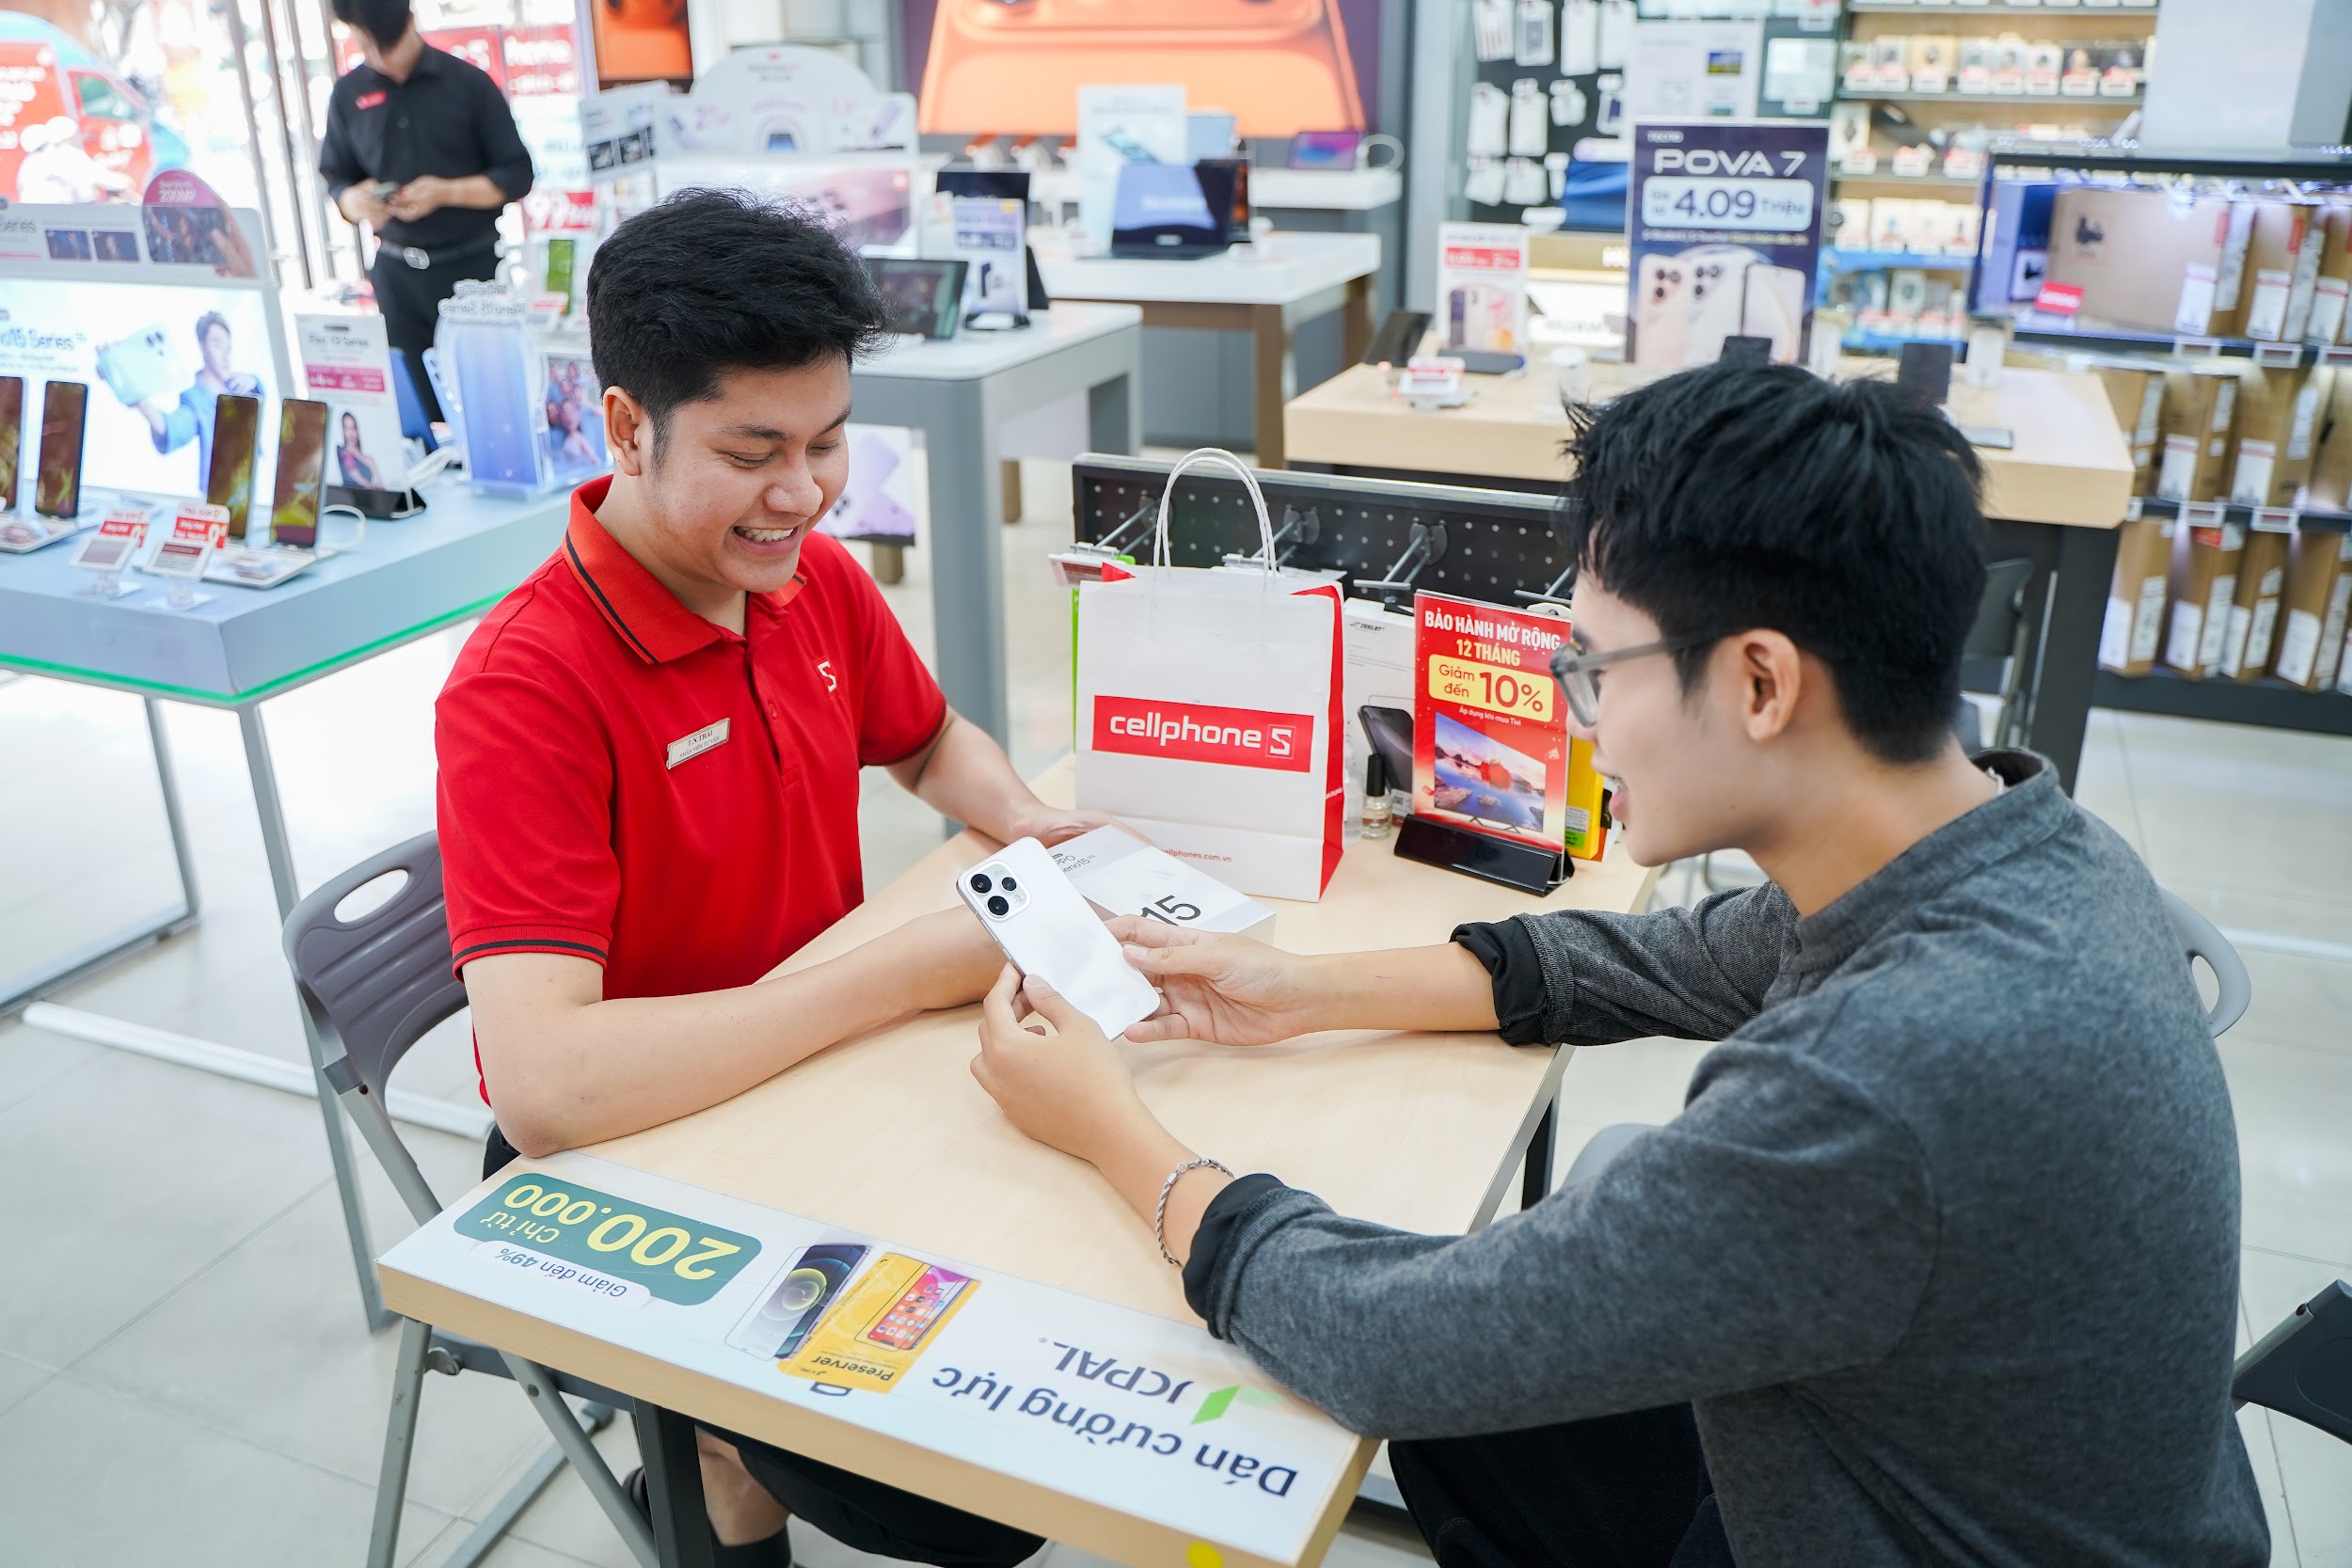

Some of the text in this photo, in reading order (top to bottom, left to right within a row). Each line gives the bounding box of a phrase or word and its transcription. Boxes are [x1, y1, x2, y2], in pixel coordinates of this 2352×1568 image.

[1654, 149, 1806, 177] POVA 7
[1675, 189, 1756, 218] 4.09
[1425, 608, 1561, 652] BẢO HÀNH MỞ RỘNG
[1456, 639, 1521, 667] 12 THÁNG
[1438, 664, 1475, 682] Giảm
[1444, 683, 1470, 698] đến
[1479, 672, 1543, 712] 10%
[1109, 712, 1262, 749] cellphone
[1469, 709, 1485, 721] dụng
[1485, 711, 1494, 721] khi
[1495, 715, 1509, 724] mua
[480, 1211, 561, 1243] Chỉ từ
[503, 1184, 741, 1280] 200.000
[494, 1247, 628, 1298] Giảm đến 49%
[811, 1355, 895, 1381] Preserver
[1053, 1341, 1195, 1404] JCPAL
[932, 1366, 1298, 1497] Dán cường lực
